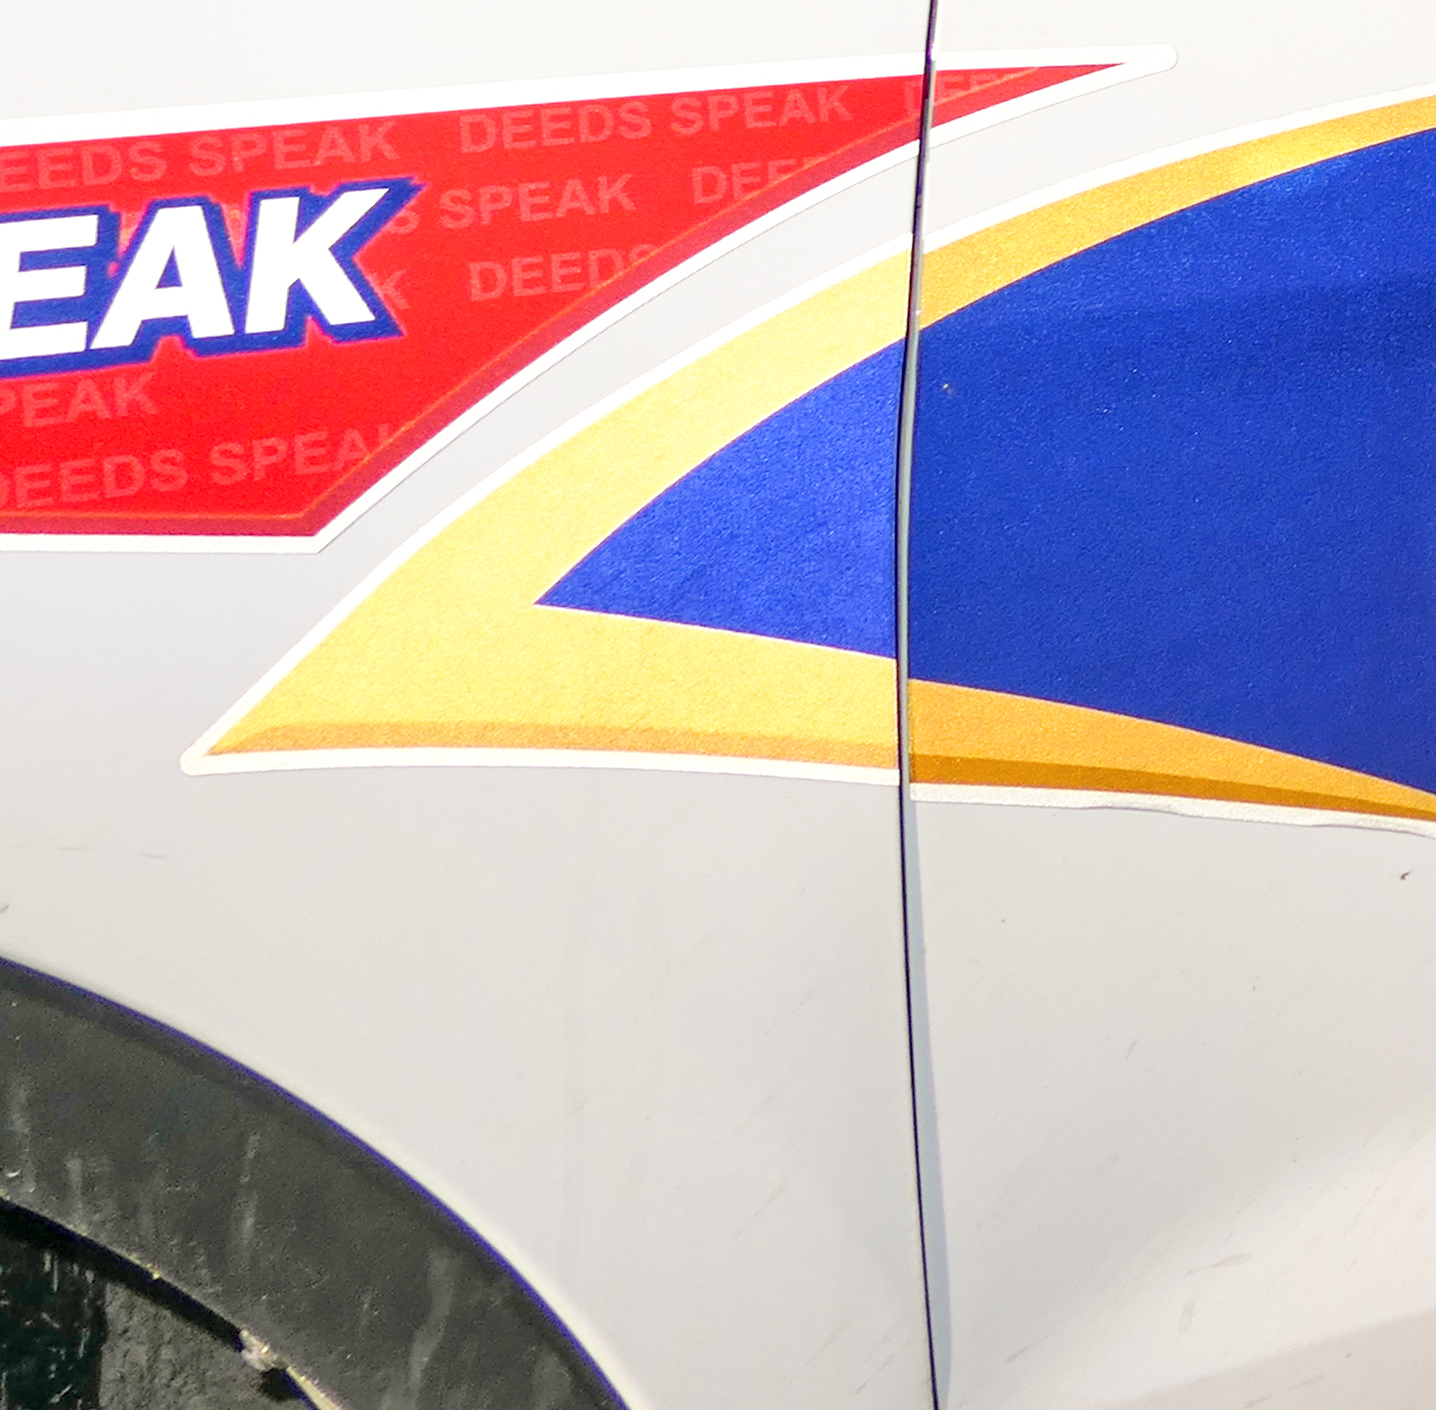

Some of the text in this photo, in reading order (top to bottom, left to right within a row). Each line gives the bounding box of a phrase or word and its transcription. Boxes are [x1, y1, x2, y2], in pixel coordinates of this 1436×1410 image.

[188, 120, 401, 178] SPEAK
[459, 98, 653, 155] DEEDS
[669, 84, 854, 137] SPEAK
[438, 172, 637, 232] SPEAK
